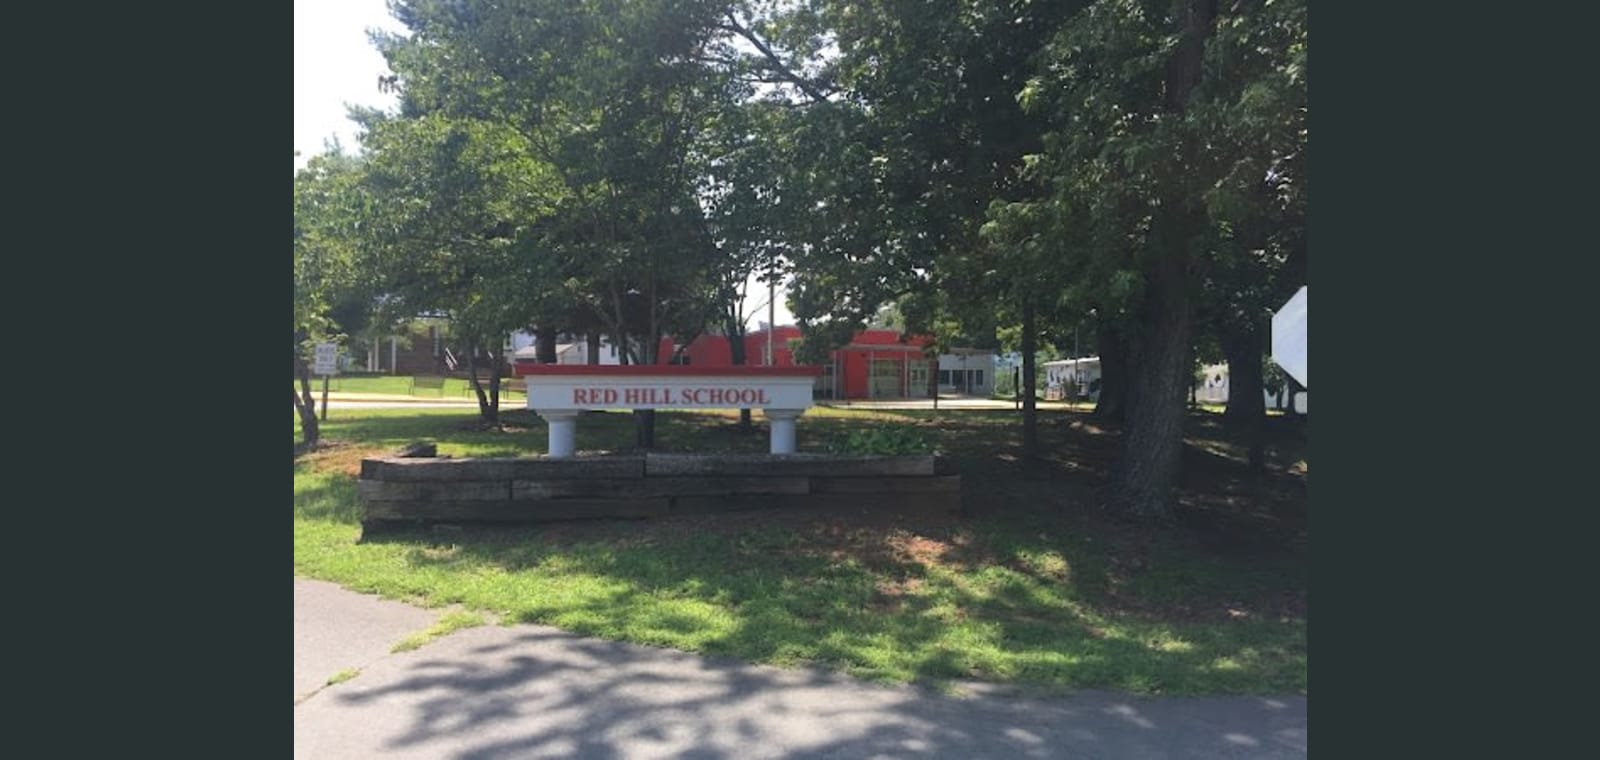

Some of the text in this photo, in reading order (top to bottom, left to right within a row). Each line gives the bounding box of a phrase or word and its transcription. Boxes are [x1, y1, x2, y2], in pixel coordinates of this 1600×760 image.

[573, 388, 770, 405] RED HILL SCHOOL
